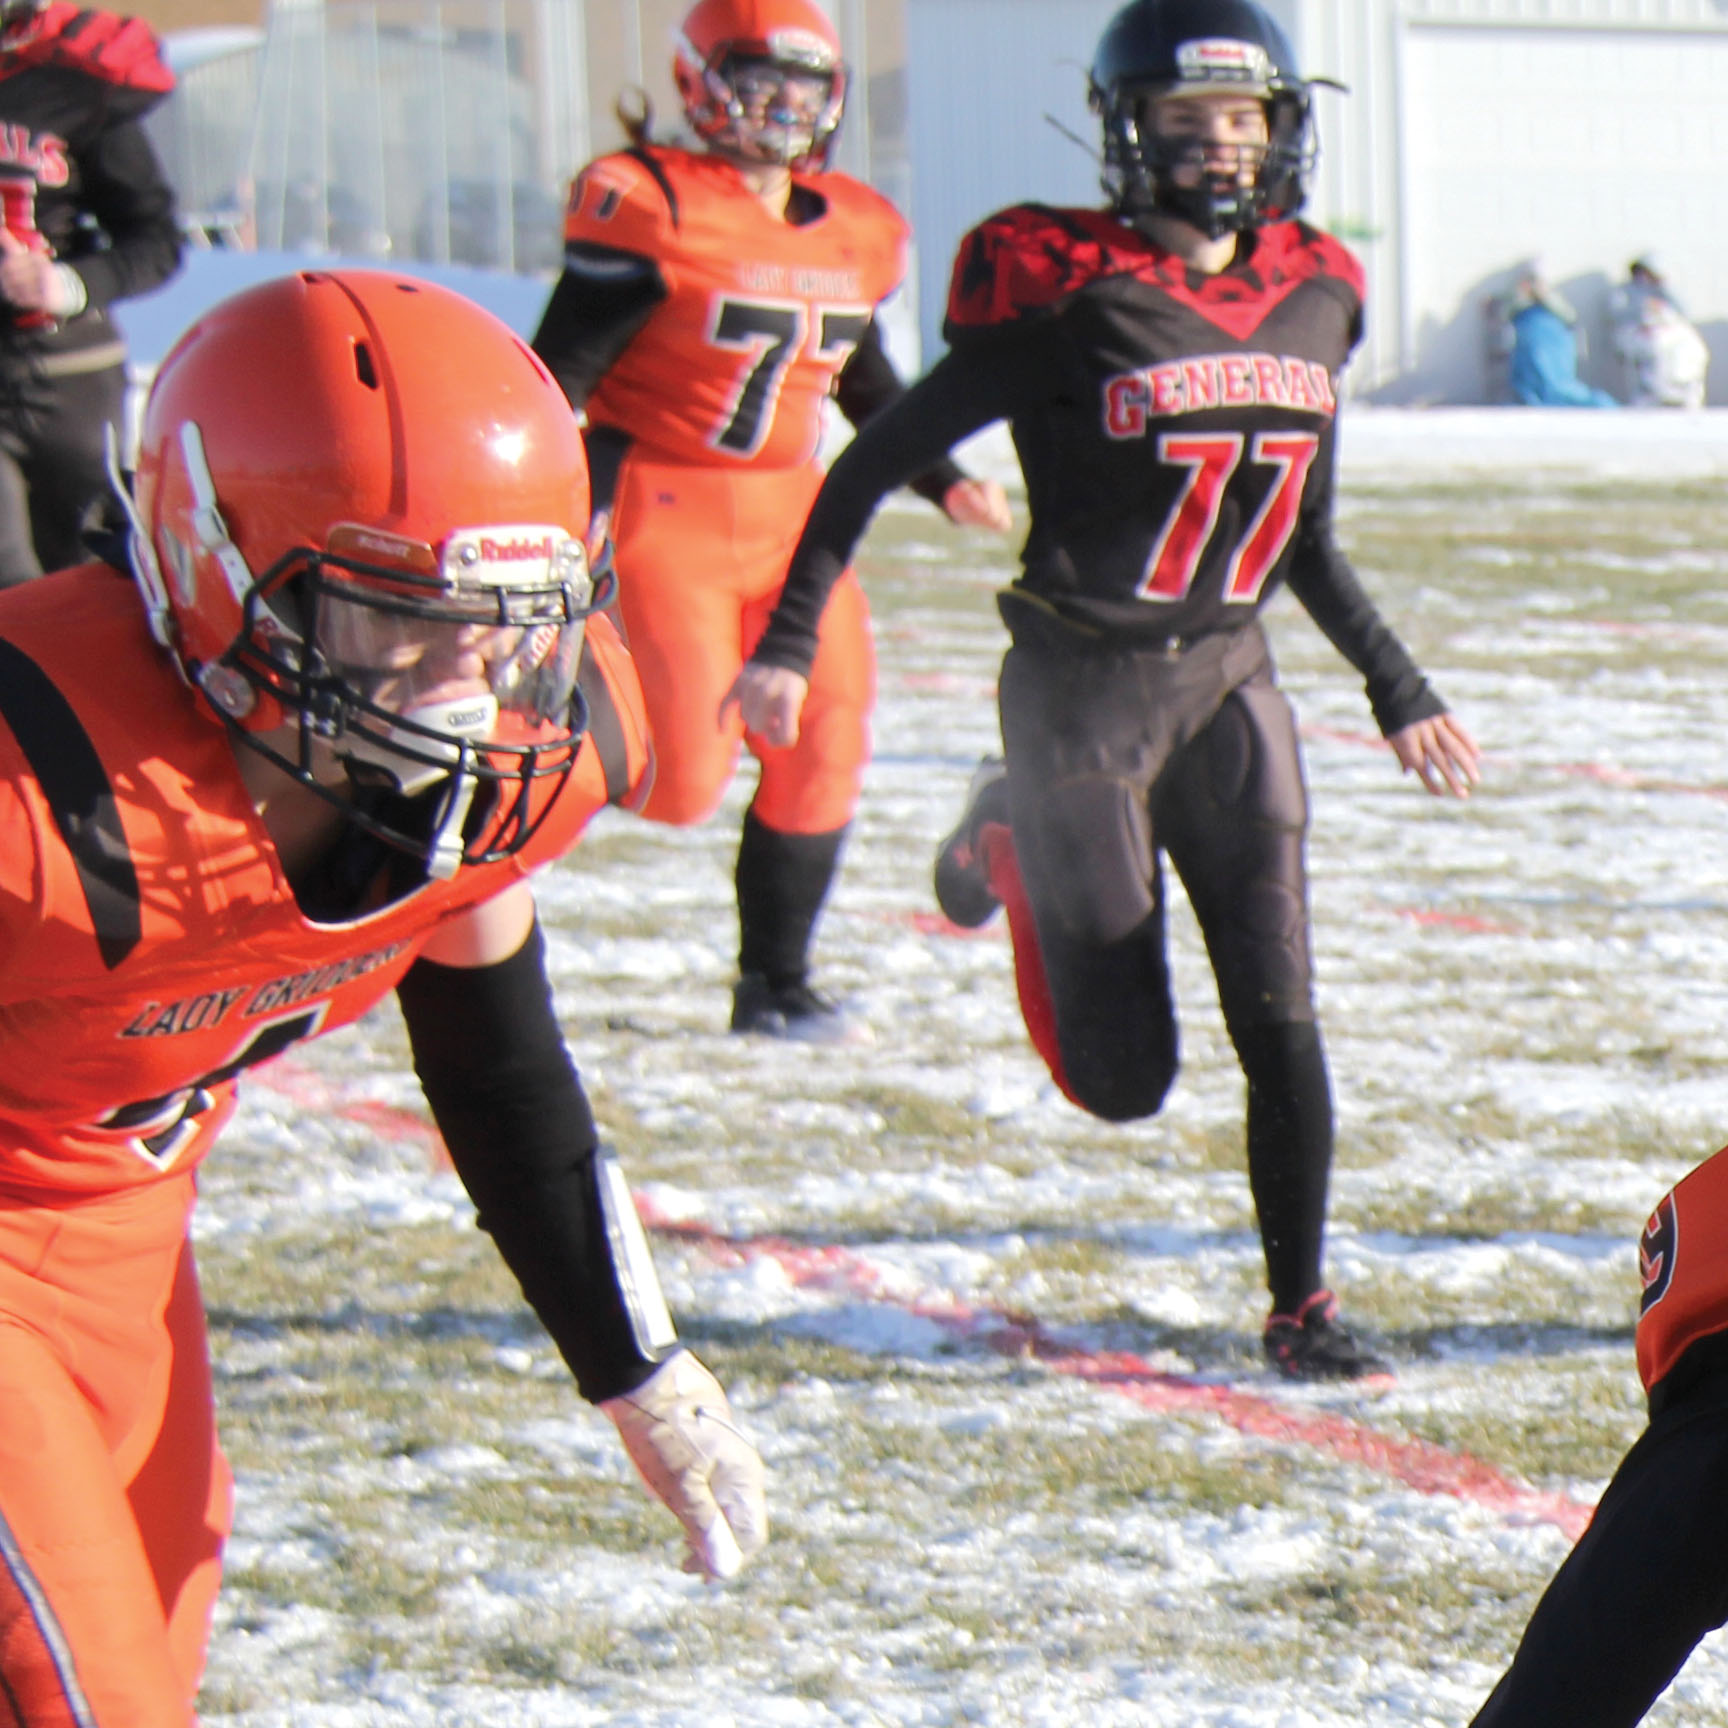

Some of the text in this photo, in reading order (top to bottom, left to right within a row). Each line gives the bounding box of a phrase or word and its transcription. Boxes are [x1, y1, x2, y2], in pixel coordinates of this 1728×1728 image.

[1105, 352, 1340, 440] GENERAL
[1135, 433, 1320, 603] 77
[116, 985, 252, 1038] LADY
